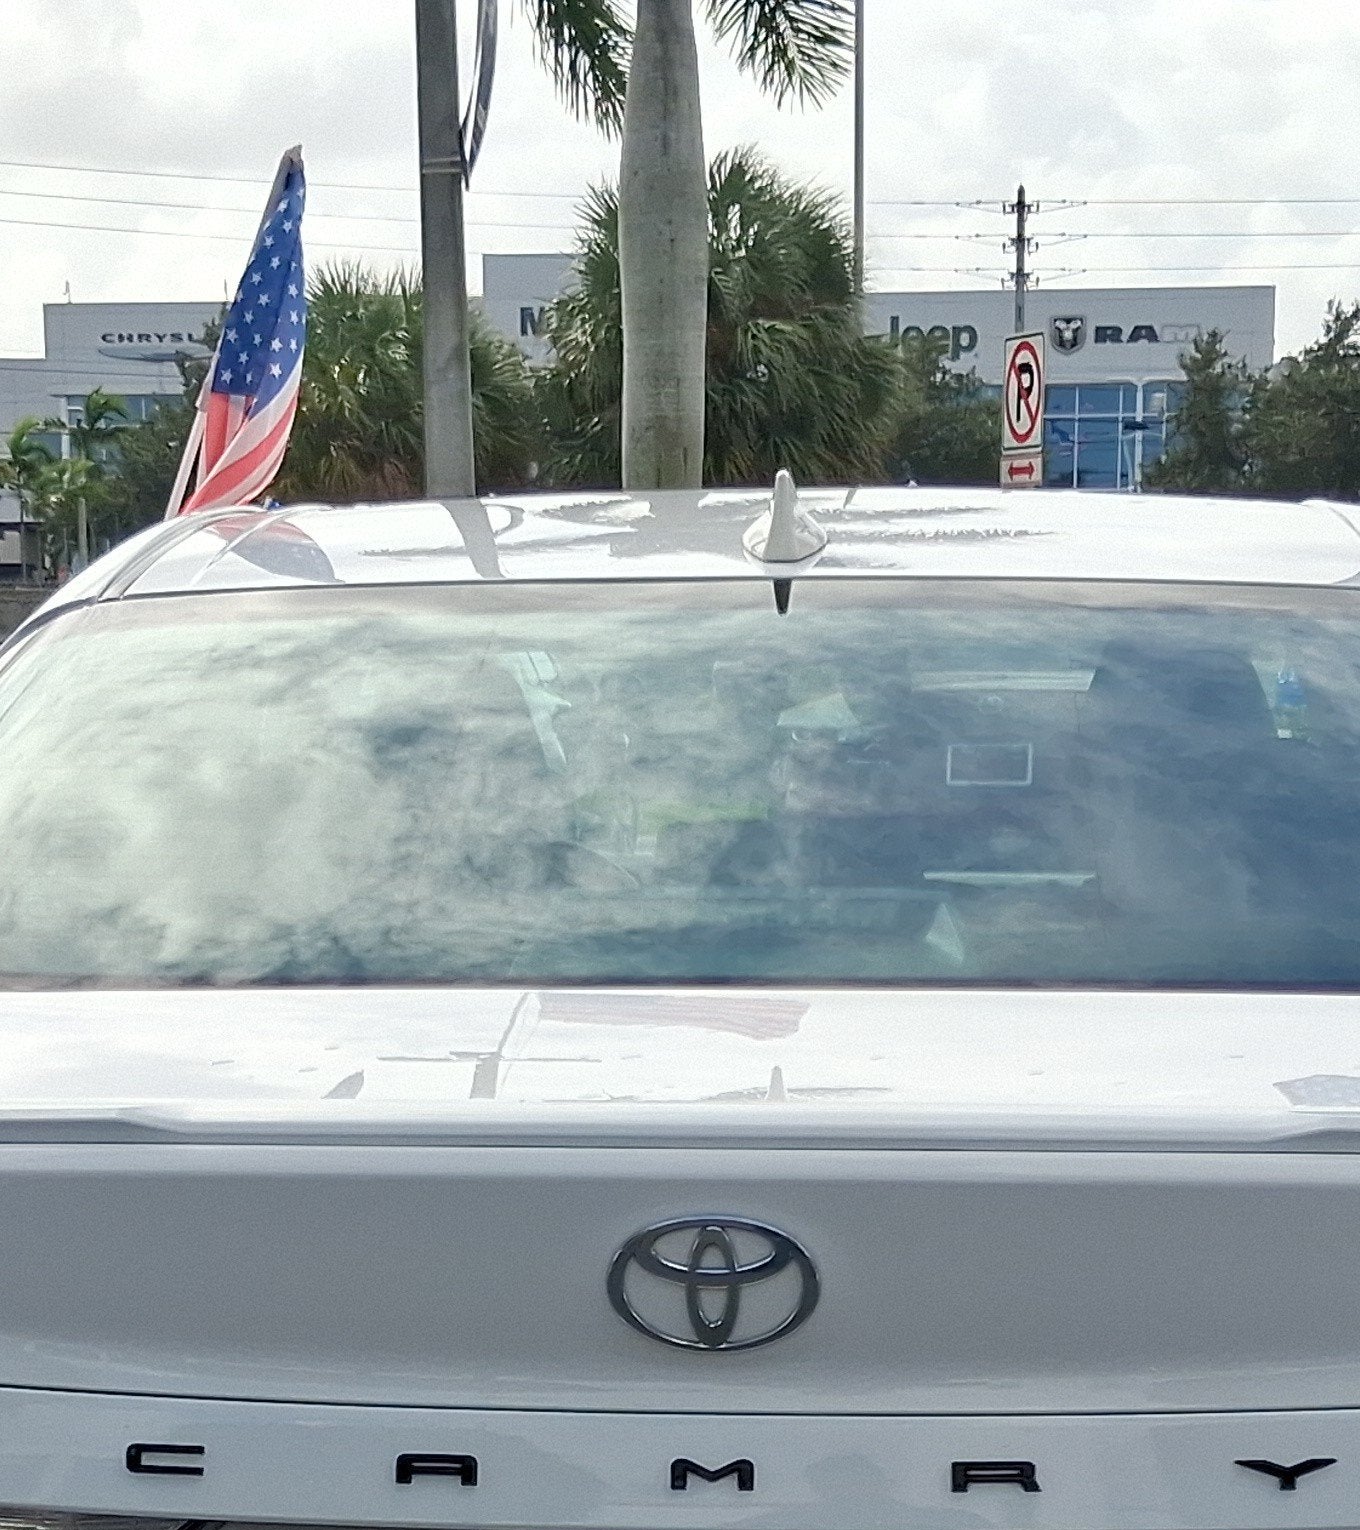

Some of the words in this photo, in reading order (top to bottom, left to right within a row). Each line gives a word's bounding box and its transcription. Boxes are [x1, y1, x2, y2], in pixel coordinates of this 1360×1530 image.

[101, 333, 197, 343] CHRYSL
[1094, 324, 1200, 344] RAM
[126, 1443, 1338, 1494] CAMRY
